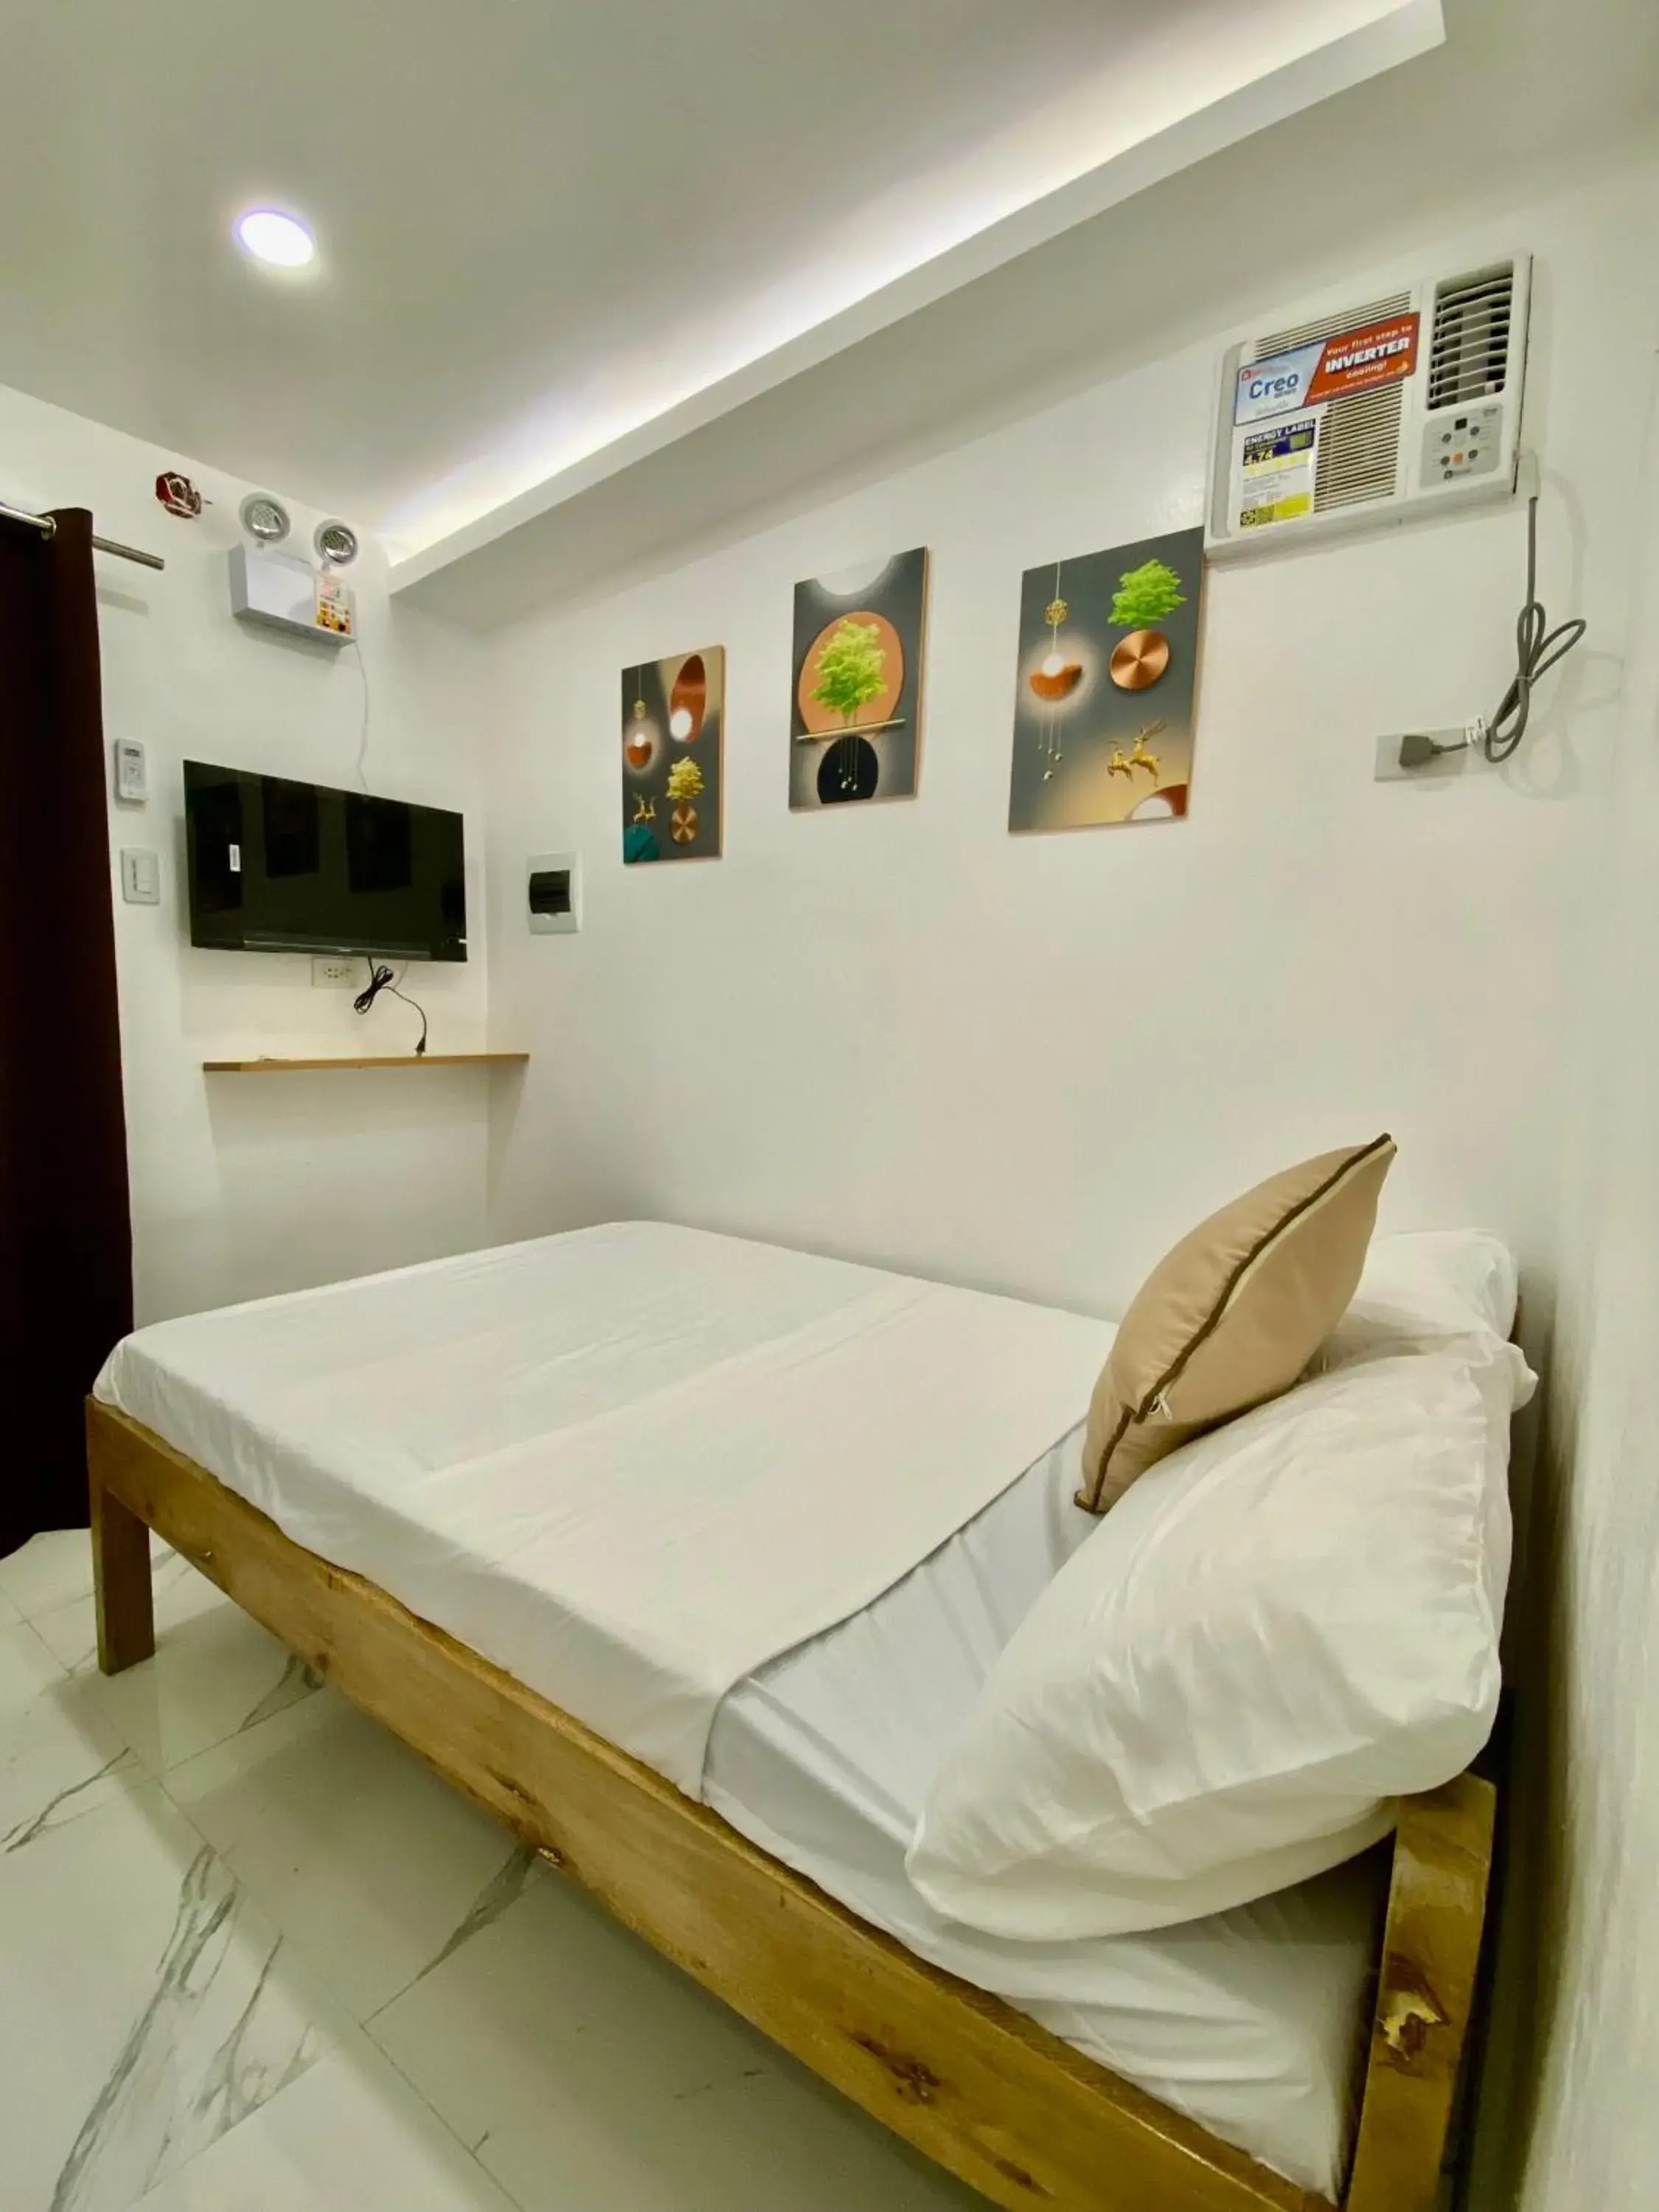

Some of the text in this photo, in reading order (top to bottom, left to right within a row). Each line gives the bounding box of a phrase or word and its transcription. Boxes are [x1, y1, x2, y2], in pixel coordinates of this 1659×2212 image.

[1327, 324, 1413, 356] Your first step to
[1325, 337, 1410, 373] INVERTER
[1346, 360, 1387, 379] cooling!
[1249, 373, 1298, 399] Creo
[1244, 428, 1283, 445] ENERGY
[1284, 420, 1315, 436] LABEL
